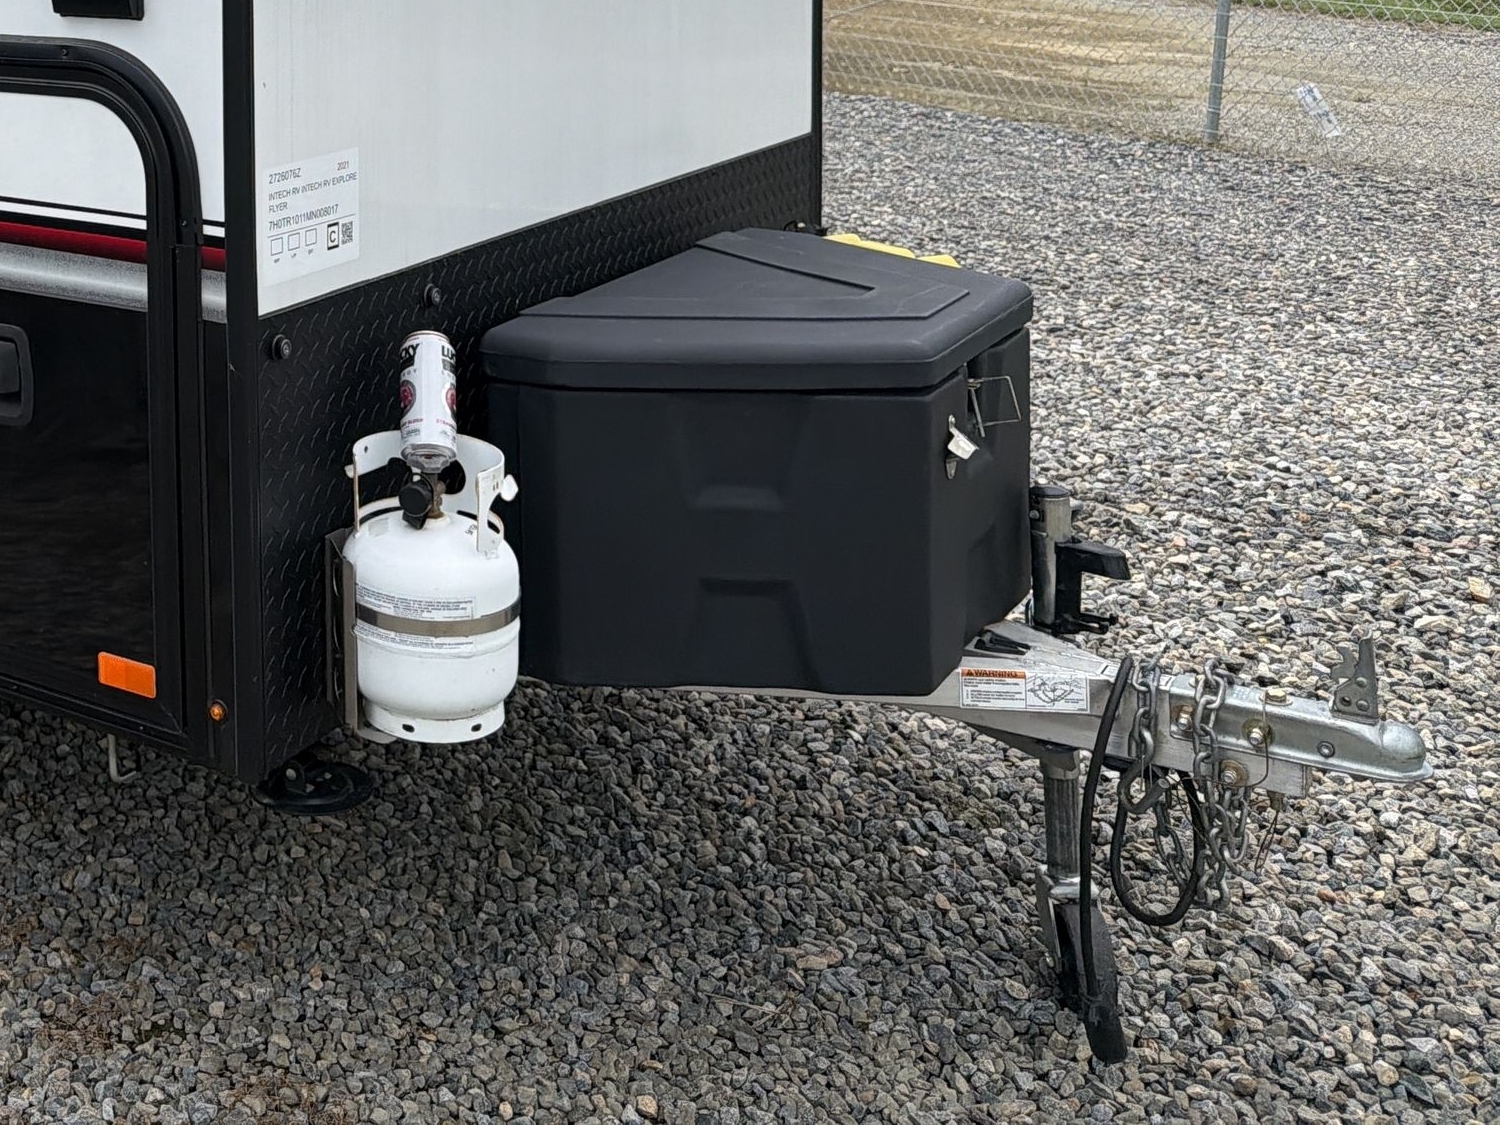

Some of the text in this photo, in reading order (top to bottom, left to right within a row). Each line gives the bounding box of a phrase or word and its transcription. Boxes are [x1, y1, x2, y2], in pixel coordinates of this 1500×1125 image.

[337, 161, 349, 171] 2021
[268, 172, 357, 201] INTECH RV INTECH RV EXPLORE
[268, 202, 288, 214] FLYER
[329, 230, 336, 243] C
[974, 669, 1018, 678] WARNING
